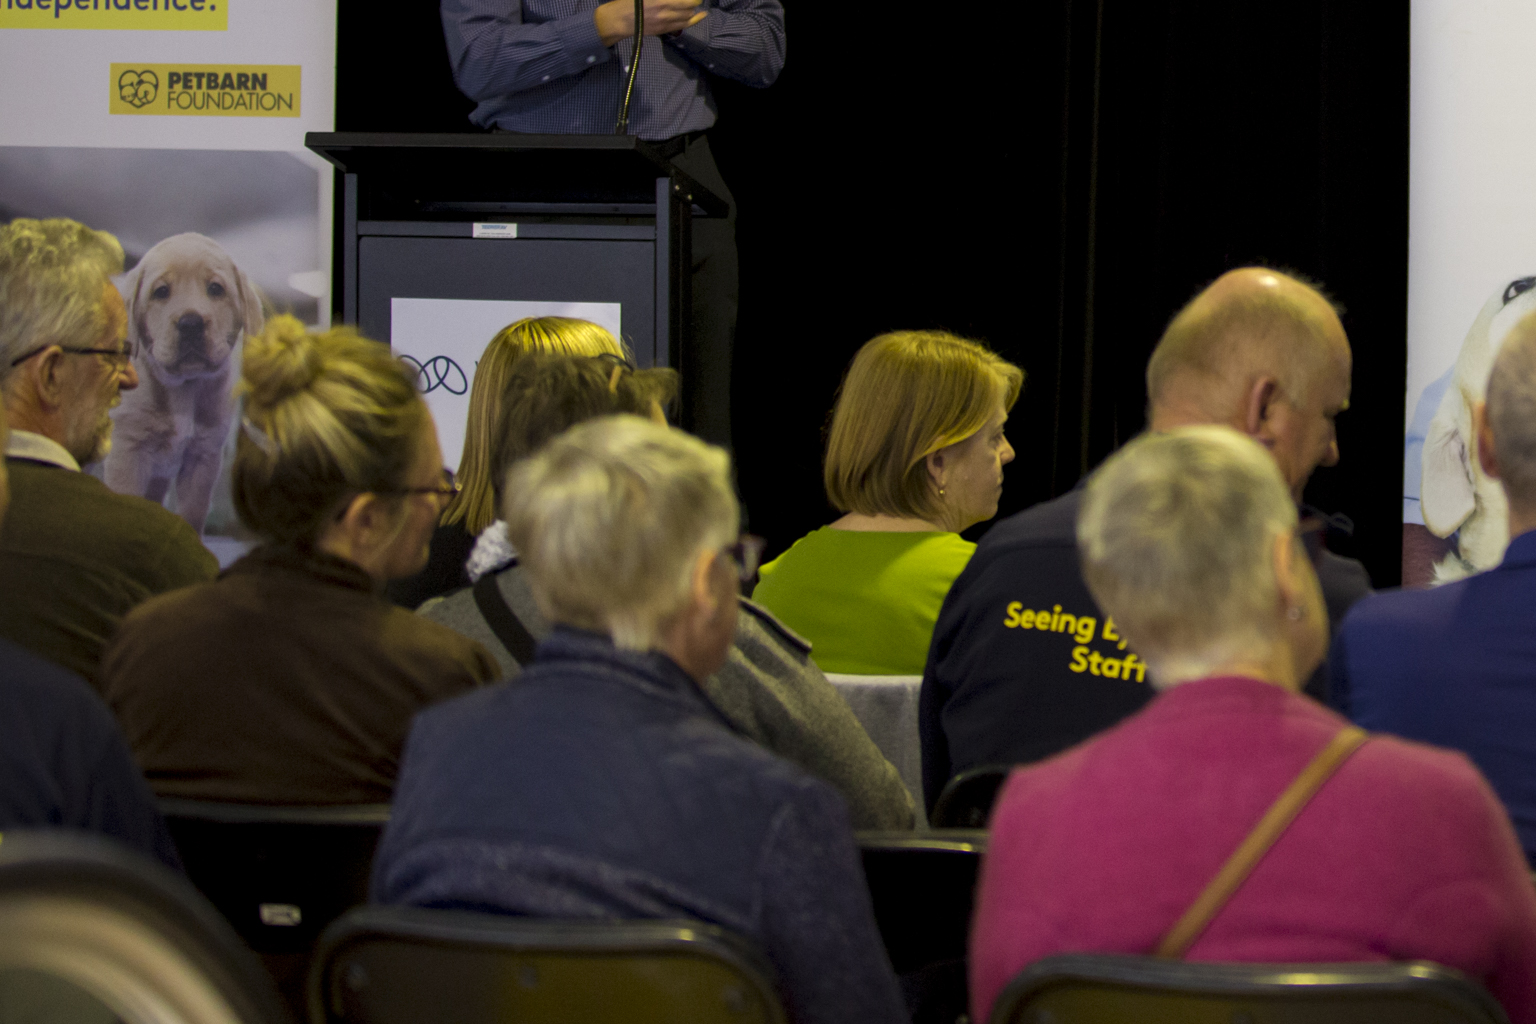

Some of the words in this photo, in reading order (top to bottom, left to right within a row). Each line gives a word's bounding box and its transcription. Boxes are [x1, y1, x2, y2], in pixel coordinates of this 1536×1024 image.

[167, 71, 268, 91] PETBARN
[167, 90, 293, 112] FOUNDATION
[1003, 601, 1096, 644] Seeing
